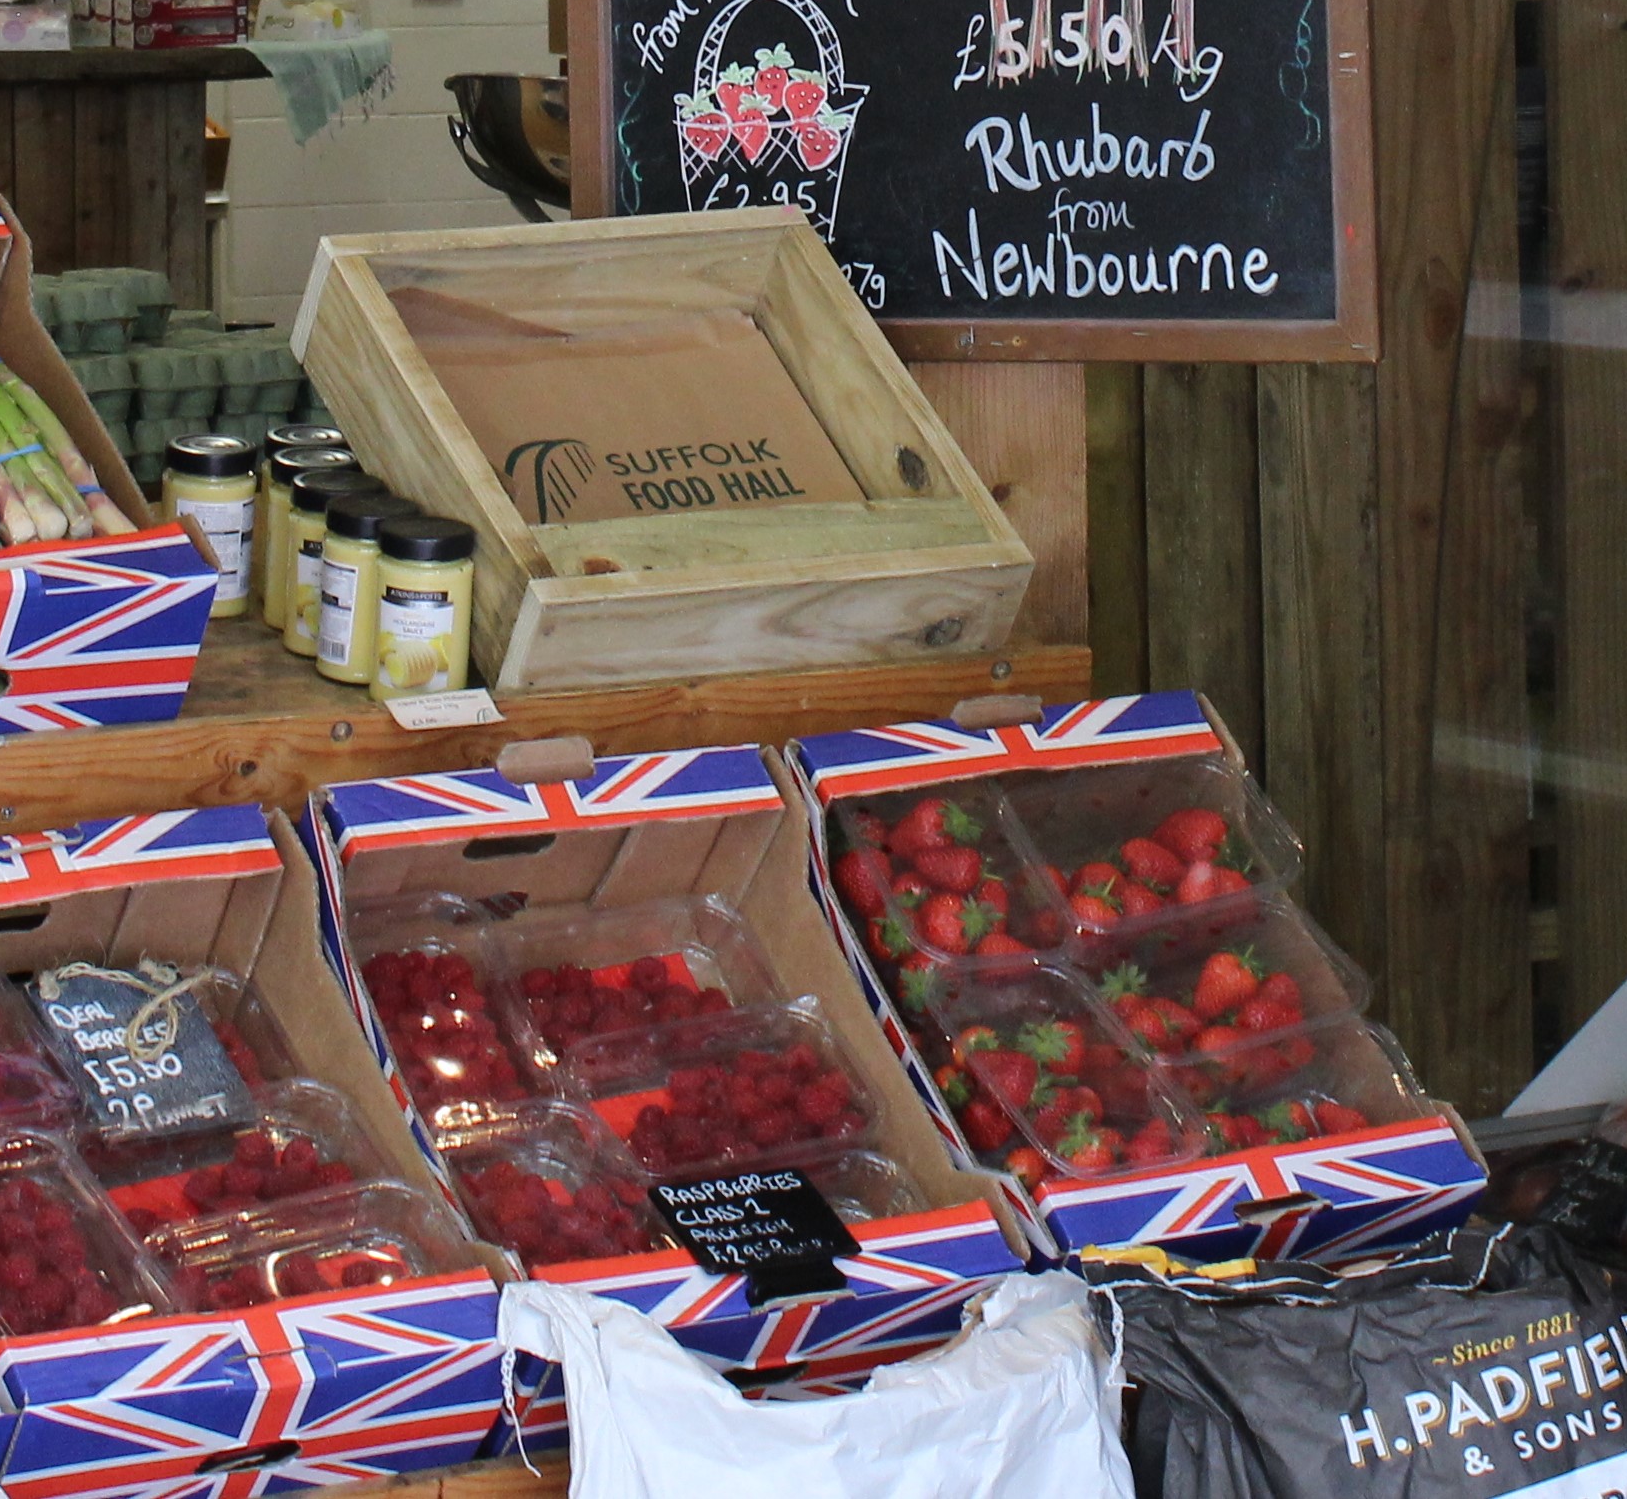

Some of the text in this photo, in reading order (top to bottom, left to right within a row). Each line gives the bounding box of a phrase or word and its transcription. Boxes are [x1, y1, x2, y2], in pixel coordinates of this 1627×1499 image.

[964, 103, 1219, 193] Rhubarb
[1050, 185, 1135, 241] from
[932, 207, 1279, 300] Newbourne
[604, 437, 781, 477] SUFFOLK
[622, 464, 806, 512] FOOD HALL
[48, 1001, 116, 1030] DEAL
[658, 1171, 802, 1206] RASPBERRIES
[675, 1197, 771, 1226] CLASS 1
[1452, 1311, 1574, 1368] Since 1881
[1463, 1400, 1623, 1477] & SONS
